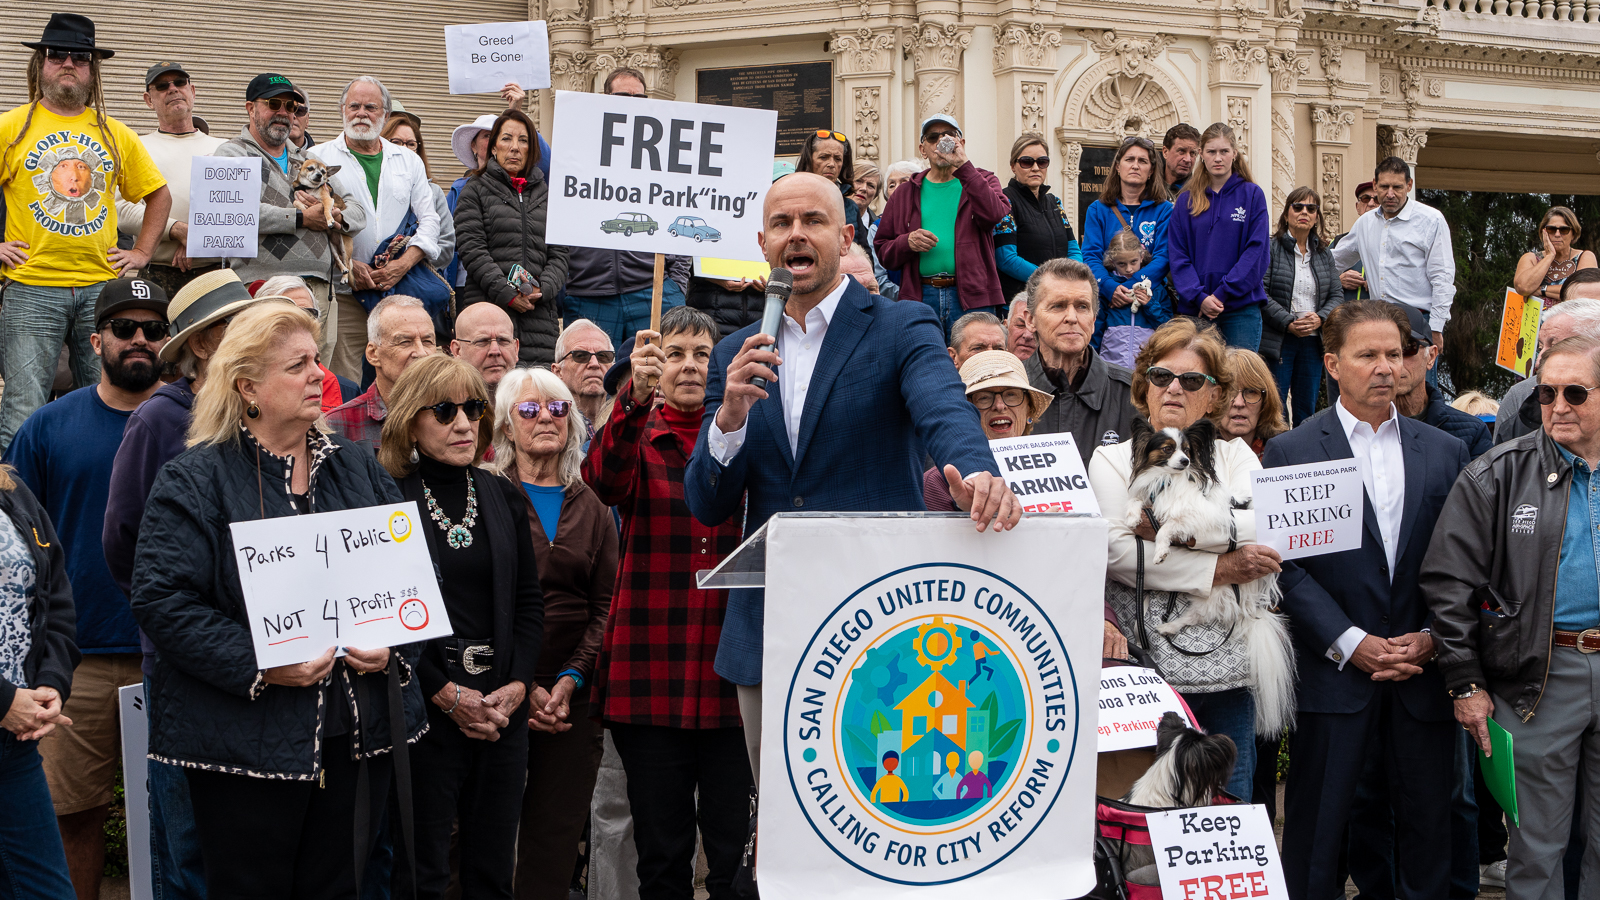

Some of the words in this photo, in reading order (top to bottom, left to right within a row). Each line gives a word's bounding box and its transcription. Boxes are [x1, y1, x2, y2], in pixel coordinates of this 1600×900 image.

[478, 35, 514, 46] Greed
[472, 53, 487, 63] Be
[24, 131, 114, 172] GLORY-HOLE
[600, 112, 725, 177] FREE
[205, 168, 251, 180] DON'T
[209, 190, 244, 203] KILL
[564, 175, 641, 204] Balboa
[28, 200, 108, 236] PRODUCTIONS
[194, 213, 255, 226] BALBOA
[203, 236, 244, 248] PARK
[1004, 453, 1057, 472] KEEP
[1009, 474, 1088, 496] ARKING
[1256, 474, 1293, 484] PAPILLONS
[1295, 471, 1312, 479] LOVE
[1313, 468, 1339, 477] BALBOA
[1284, 483, 1335, 504] KEEP
[1267, 504, 1352, 530] PARKING
[240, 546, 295, 572] Parks
[315, 533, 329, 568] 4
[338, 528, 391, 553] Public
[1288, 529, 1334, 550] FREE
[876, 580, 966, 616] UNITED
[263, 609, 306, 637] NOT
[323, 599, 339, 638] 4
[347, 591, 396, 618] Profit
[812, 608, 874, 680] DIEGO
[974, 587, 1066, 732] COMMUNITIES
[1100, 677, 1126, 690] ons
[1128, 674, 1162, 686] Love
[1126, 691, 1161, 706] Park
[799, 688, 827, 740] SAN
[1098, 725, 1111, 736] ep
[1113, 719, 1157, 732] Parking
[806, 767, 880, 854] CALLING
[884, 840, 927, 867] FOR
[936, 832, 983, 865] CITY
[988, 758, 1054, 843] REFORM
[1179, 812, 1240, 836] Keep
[1164, 840, 1268, 868] Parking
[1179, 870, 1269, 900] FREE
